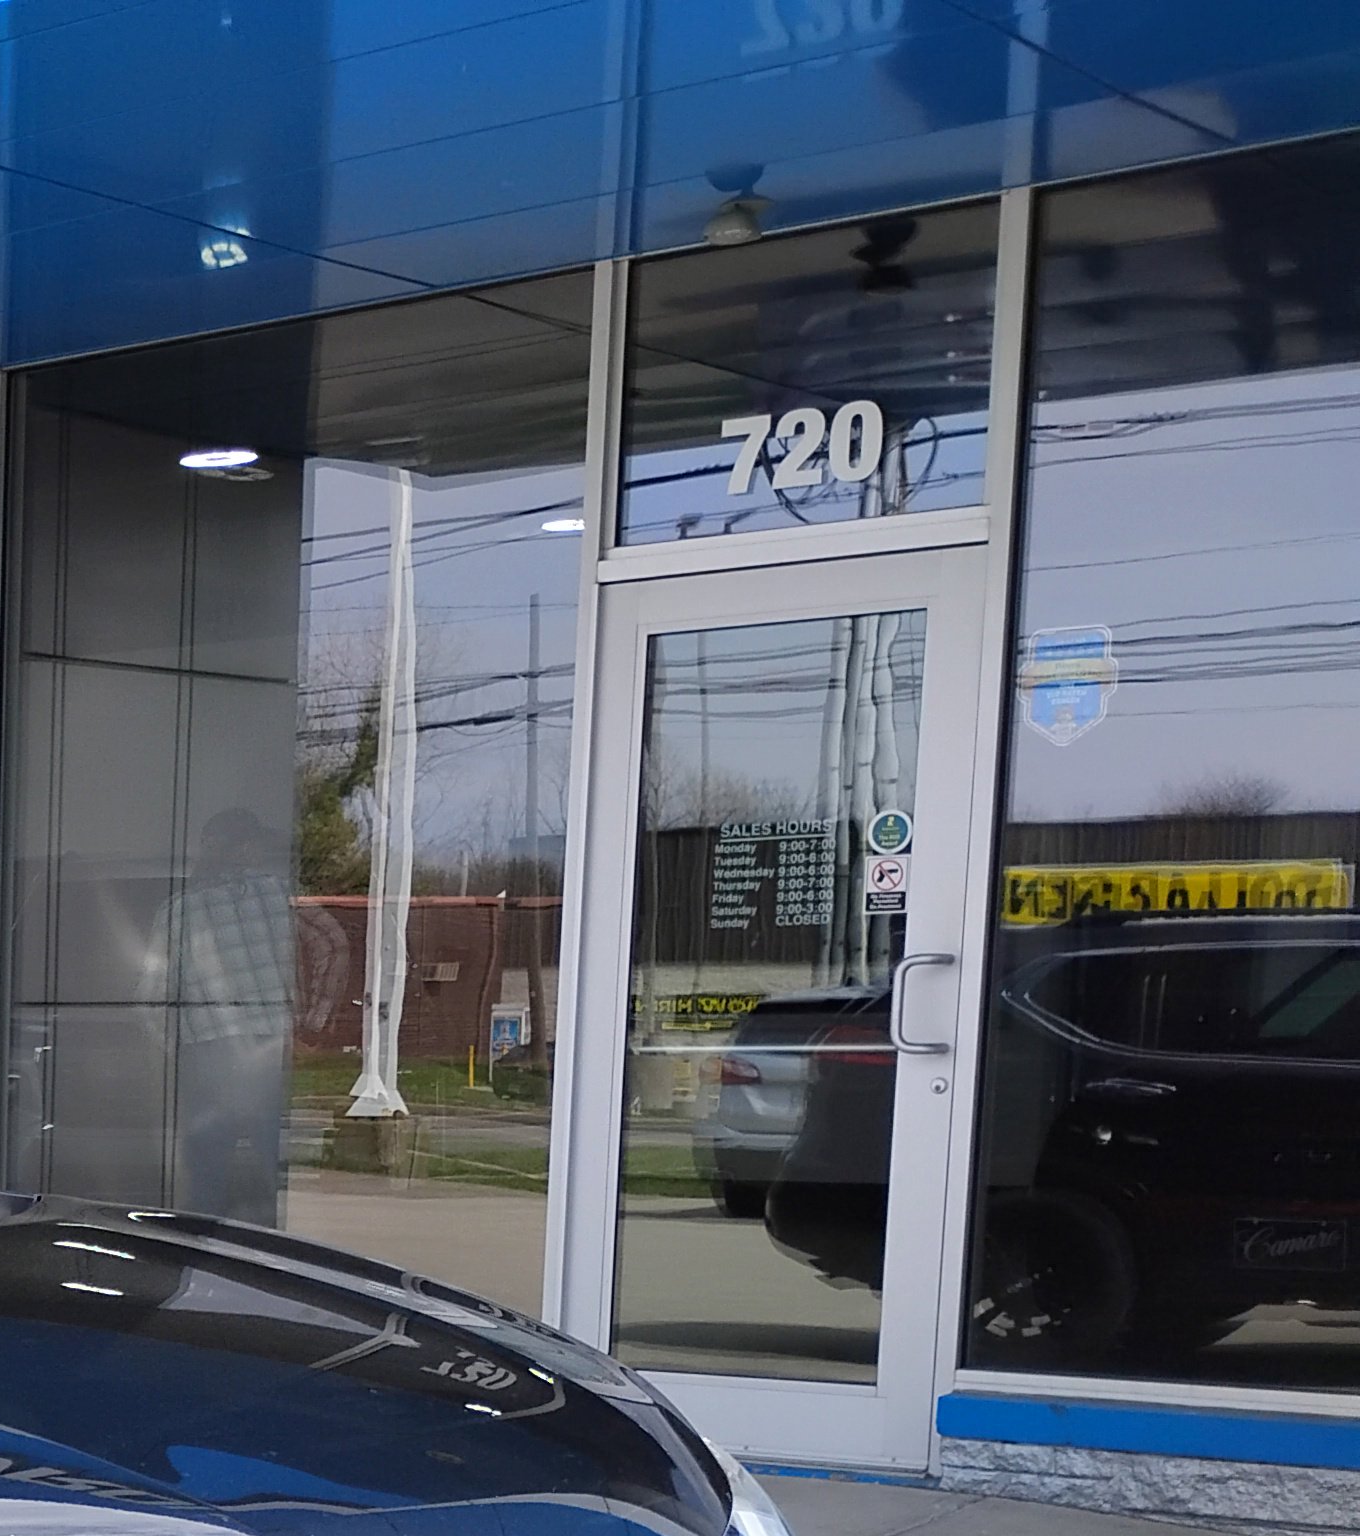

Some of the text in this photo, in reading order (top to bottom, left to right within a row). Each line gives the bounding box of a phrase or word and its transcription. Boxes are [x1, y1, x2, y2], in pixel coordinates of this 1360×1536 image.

[721, 399, 883, 495] 720
[720, 820, 831, 838] SALES HOURS
[715, 839, 836, 854] Monday 9:00-7:00
[714, 852, 835, 867] Tuesday 9:00-6:00
[713, 864, 835, 879] Wednesday 9:00-6:00
[713, 877, 834, 892] Thursday 9:00-7:00
[712, 890, 834, 905] Friday 9:00-6:00
[711, 902, 834, 917] Saturday 9:00-3:00
[710, 914, 830, 930] Sunday CLOSED
